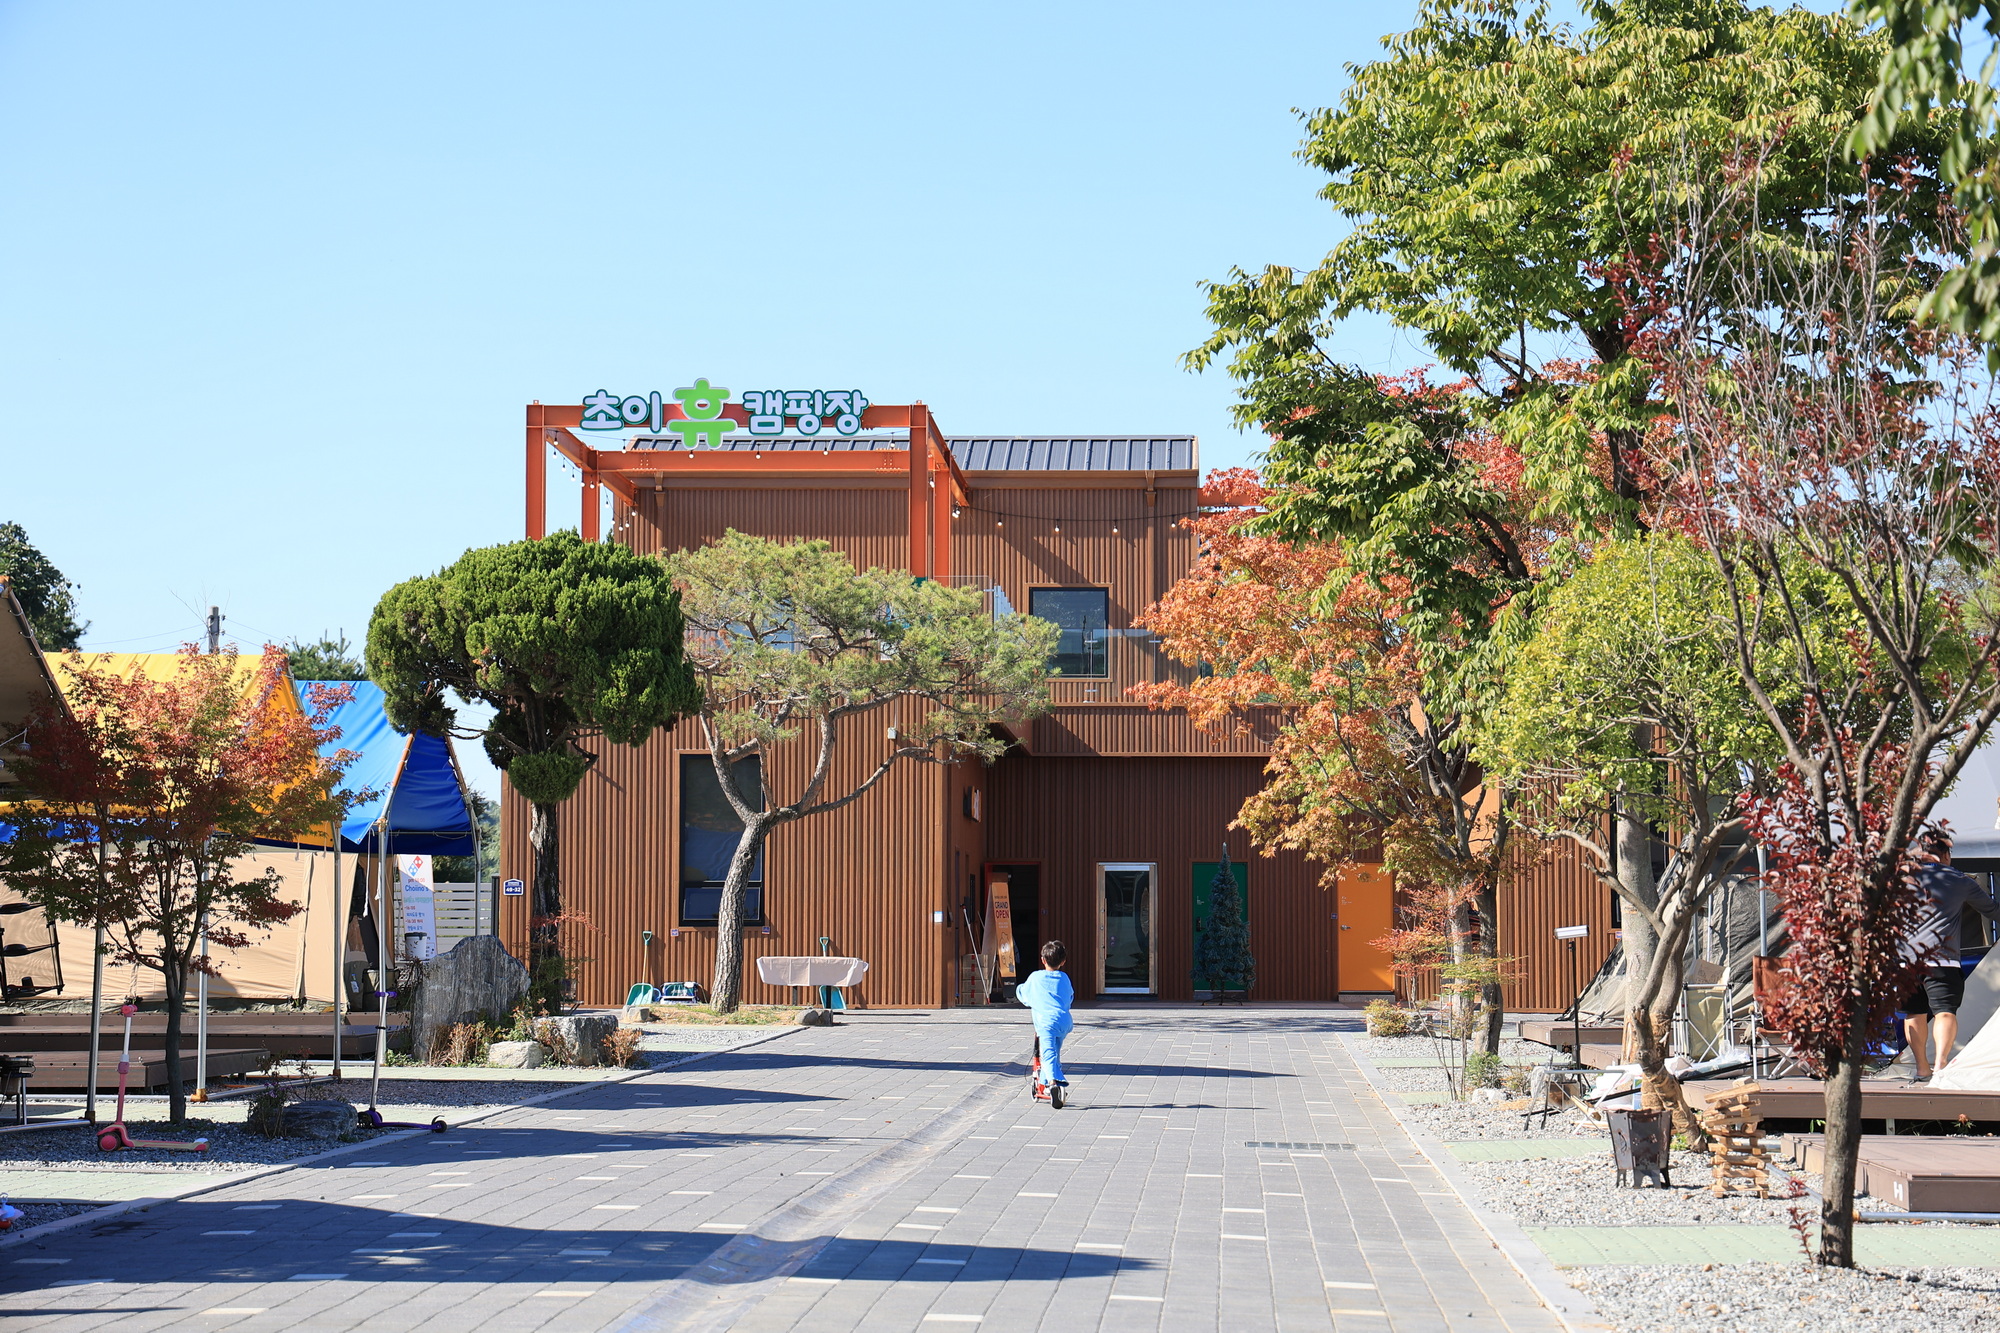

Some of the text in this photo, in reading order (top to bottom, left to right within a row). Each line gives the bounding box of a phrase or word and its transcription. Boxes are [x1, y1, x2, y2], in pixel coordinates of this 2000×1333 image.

[579, 377, 869, 450] 초이 휴 캠핑장
[995, 901, 1009, 909] GRAND
[996, 910, 1010, 919] OPEN
